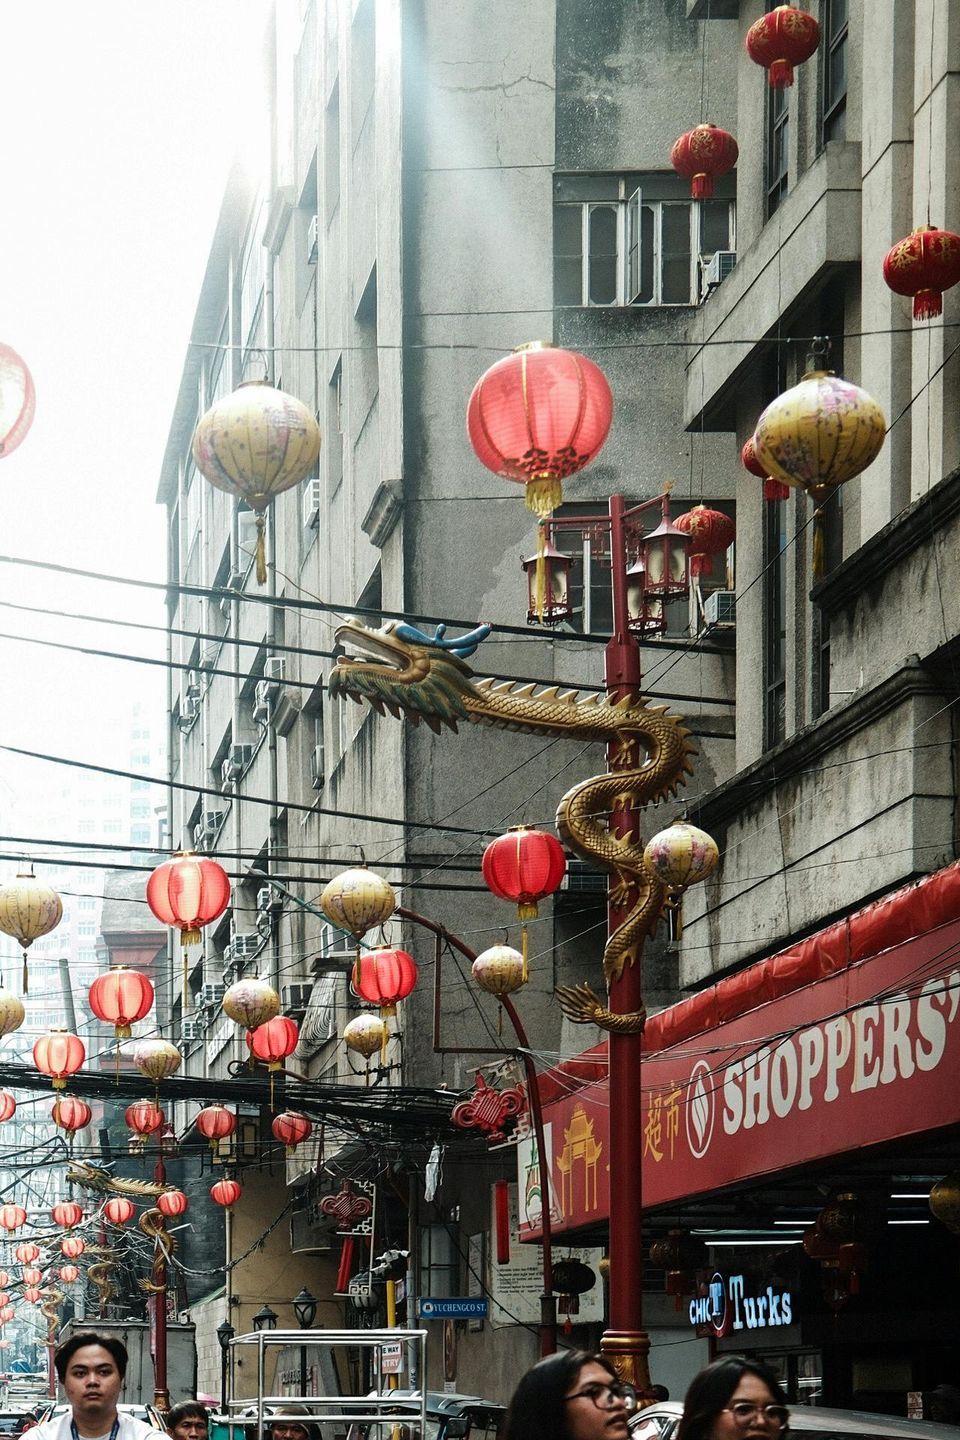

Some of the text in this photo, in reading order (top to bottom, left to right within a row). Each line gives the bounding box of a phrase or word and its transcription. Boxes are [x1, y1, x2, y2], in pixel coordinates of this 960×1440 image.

[723, 970, 960, 1135] SHOPPERS'
[729, 1274, 792, 1330] Turks
[433, 1303, 487, 1313] YUCHENGCO ST.
[387, 1346, 399, 1354] WAY
[381, 1358, 400, 1368] NTRY
